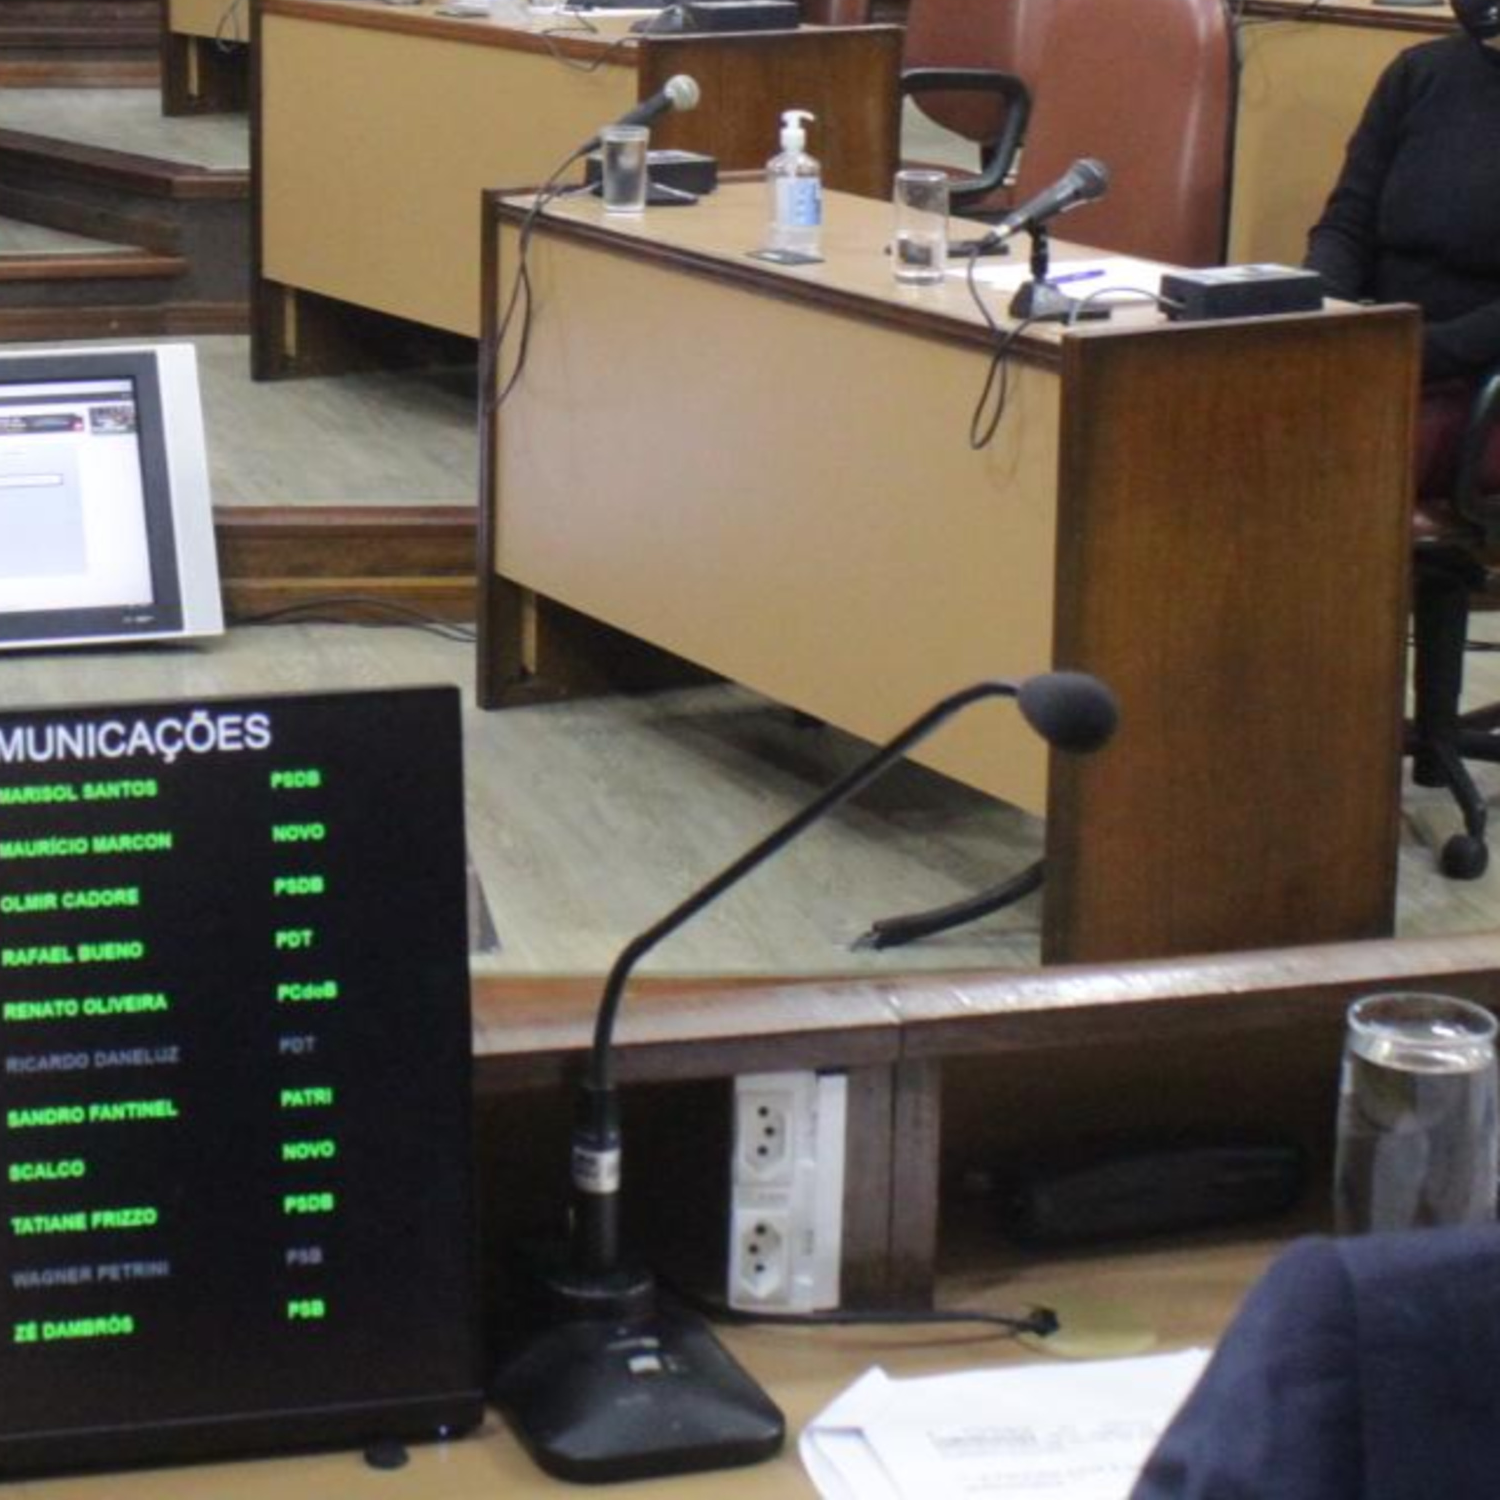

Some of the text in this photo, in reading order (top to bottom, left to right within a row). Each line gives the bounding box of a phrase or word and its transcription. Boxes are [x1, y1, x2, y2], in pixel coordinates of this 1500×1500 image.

[271, 770, 320, 788] PSDB
[82, 780, 157, 799] SANTOS
[272, 823, 325, 841] NOVO
[94, 832, 172, 852] MARCON
[274, 876, 324, 894] PSDB
[0, 888, 138, 912] OLMIR CADORE
[276, 930, 312, 948] PDT
[2, 942, 143, 966] RAFAEL BUENO
[4, 994, 167, 1020] RENATO OLIVEIRA
[279, 1036, 314, 1053] PDT
[6, 1046, 178, 1072] RICARDO DANELUZ
[281, 1088, 332, 1106] PATRI
[7, 1100, 177, 1127] SANDRO FANTINEL
[283, 1140, 335, 1159] NOVO
[9, 1160, 85, 1181] SCALCO
[284, 1193, 333, 1212] PSDB
[11, 1208, 157, 1234] TATIANE FRIZZO
[287, 1247, 322, 1264] PSB
[13, 1261, 169, 1287] WAGNER PETRINI
[288, 1300, 324, 1317] PSB
[14, 1322, 38, 1342] ZÉ
